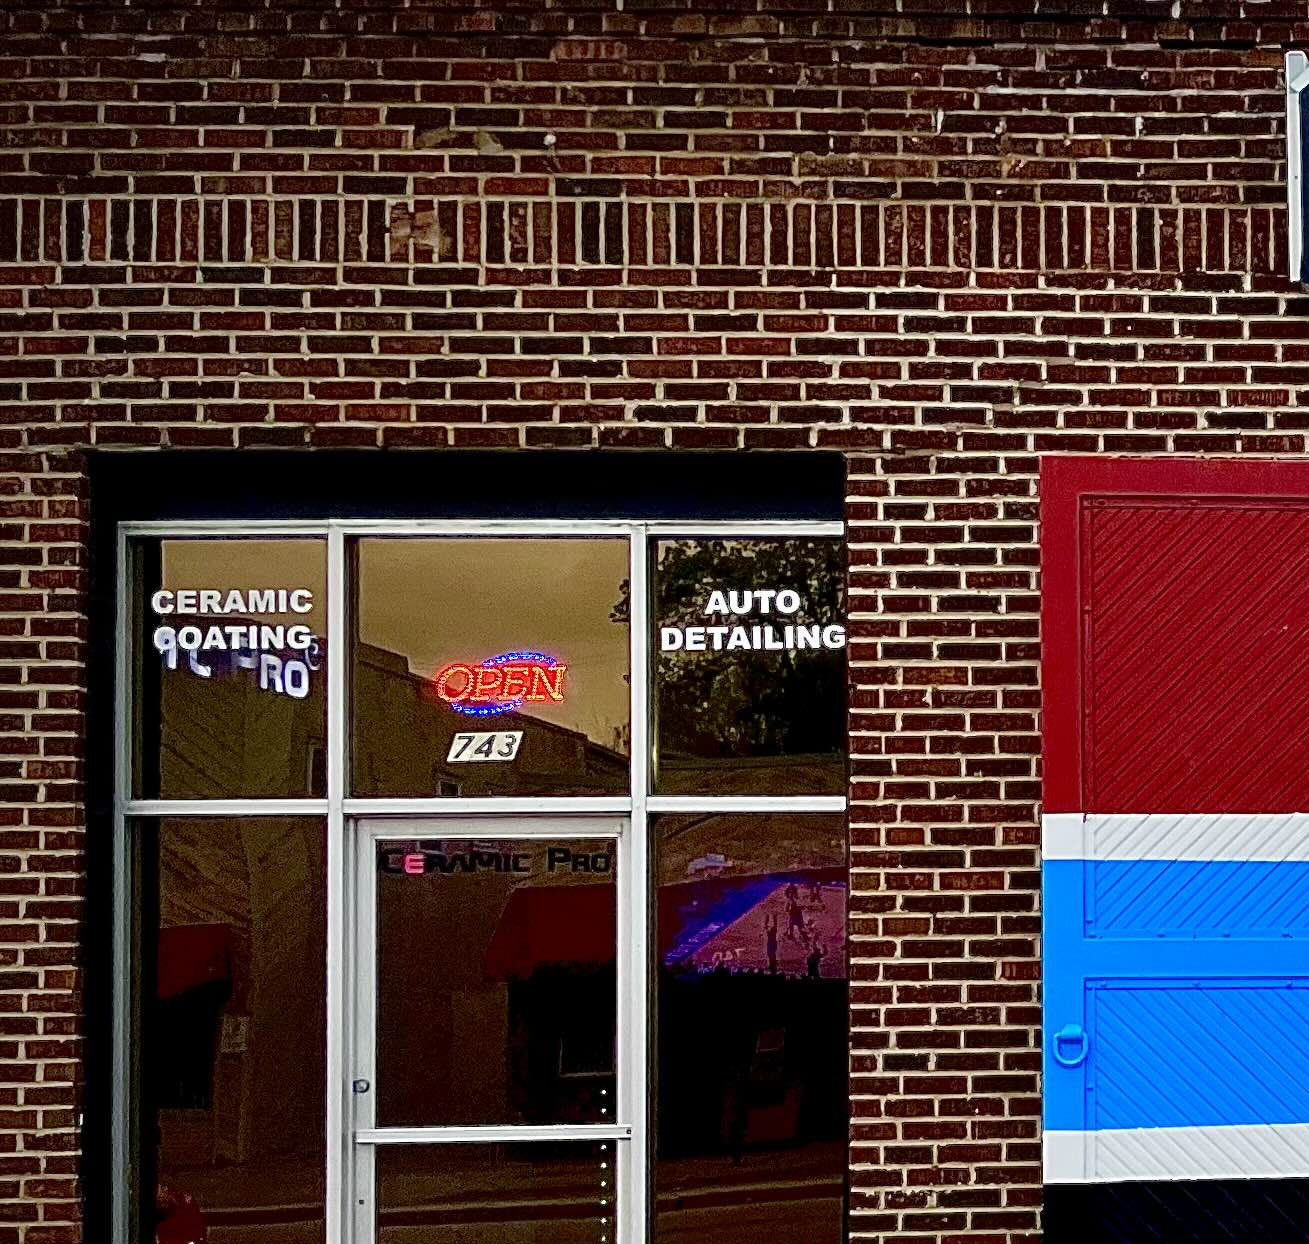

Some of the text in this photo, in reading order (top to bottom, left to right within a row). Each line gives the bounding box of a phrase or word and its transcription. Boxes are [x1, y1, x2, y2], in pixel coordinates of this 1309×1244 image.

[152, 589, 314, 615] CERAMIC
[704, 589, 801, 615] AUTO
[153, 625, 313, 651] COATING
[660, 624, 846, 651] DETAILING
[436, 664, 567, 702] OPEN
[454, 733, 518, 759] 743
[546, 846, 613, 873] PRO
